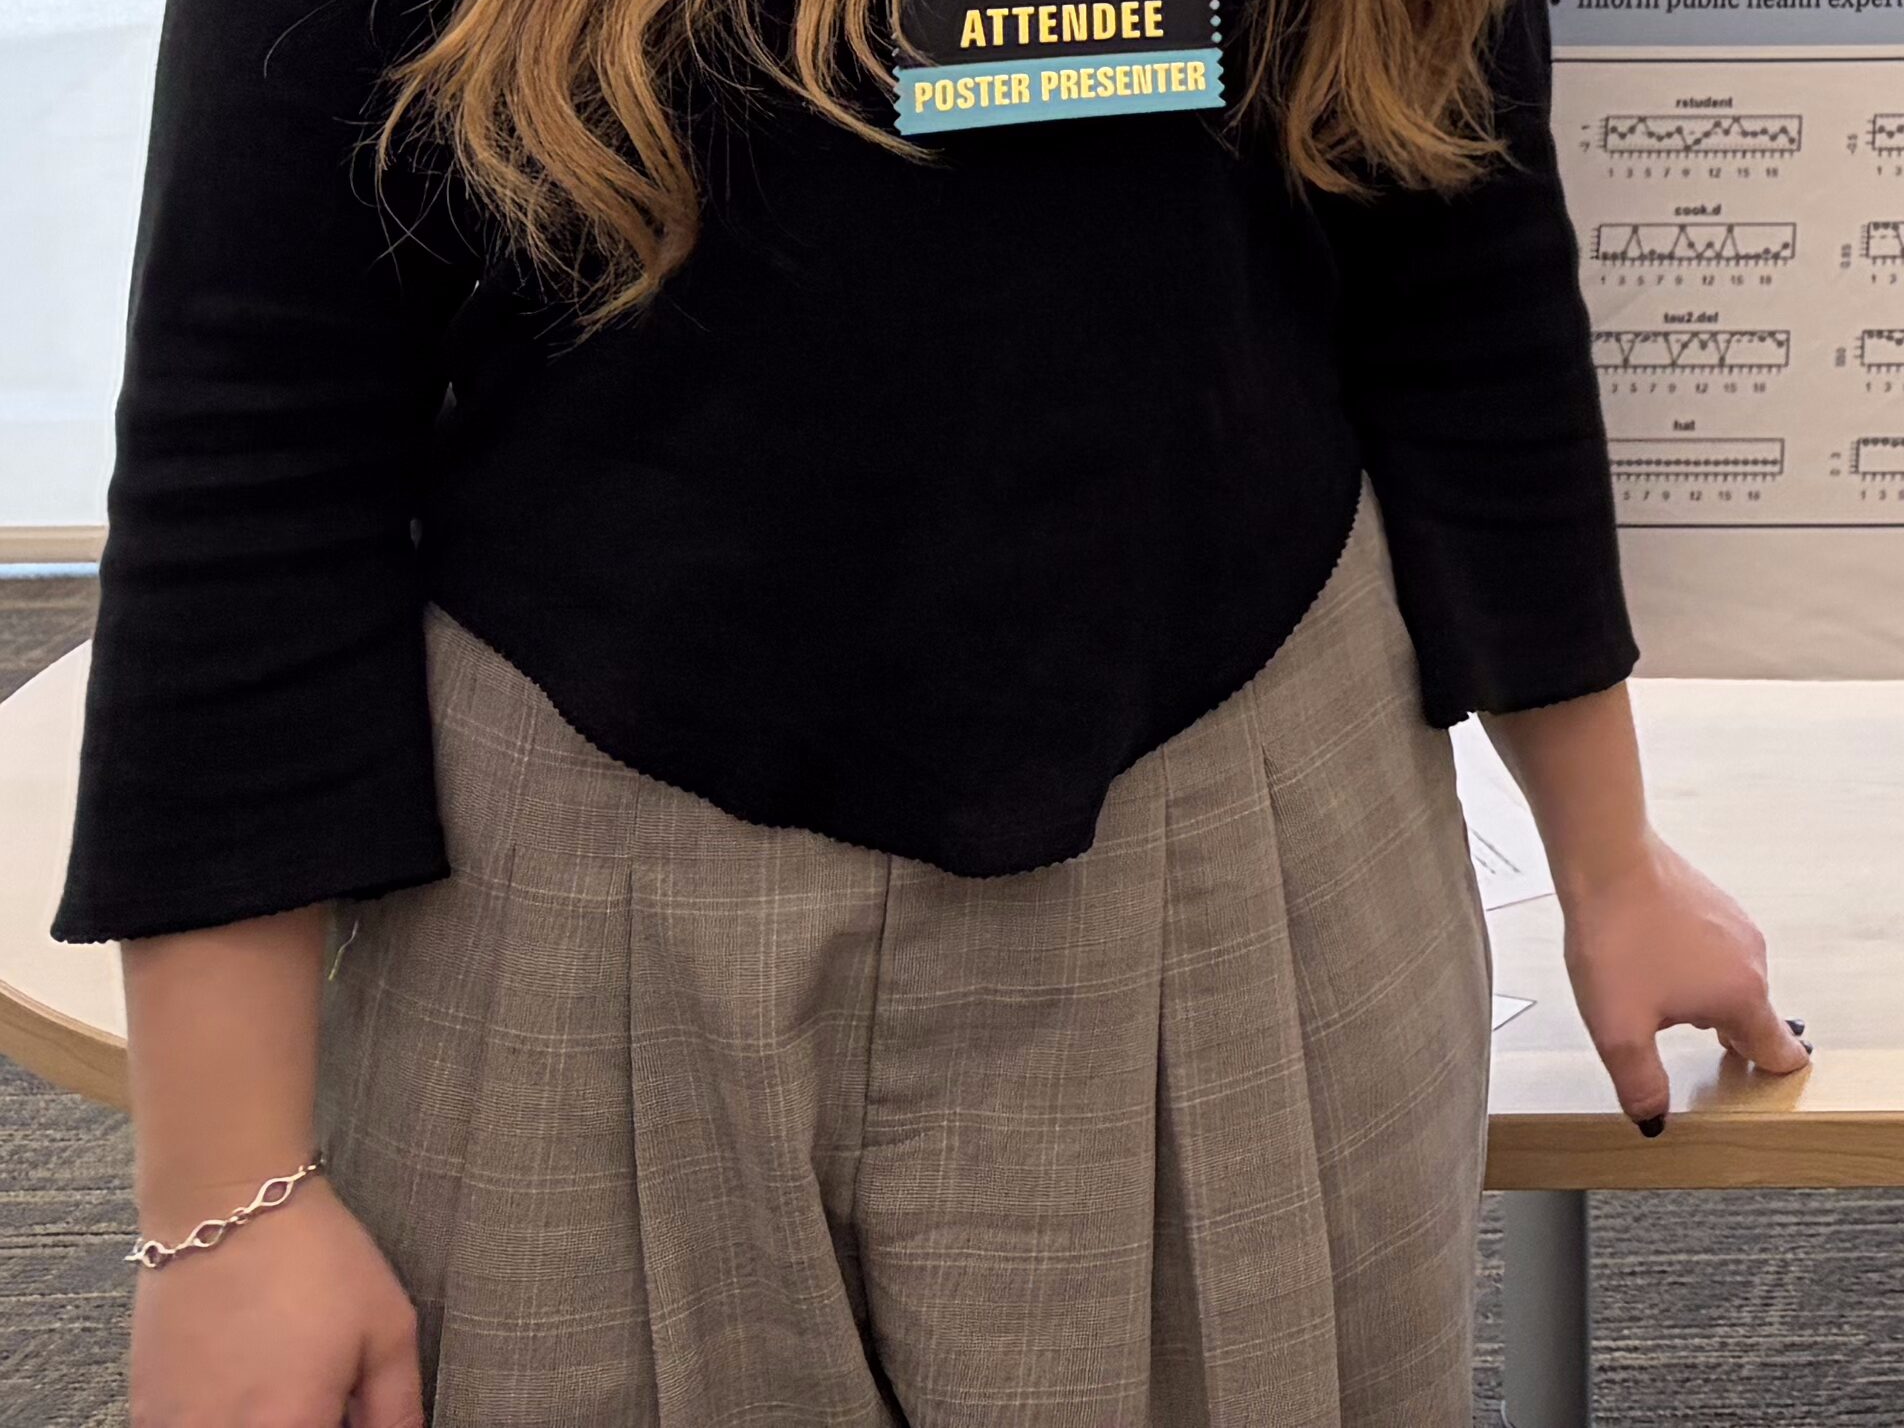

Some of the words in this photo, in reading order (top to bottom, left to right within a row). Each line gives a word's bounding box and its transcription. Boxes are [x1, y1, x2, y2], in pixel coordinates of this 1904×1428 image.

[959, 0, 1164, 49] ATTENDEE
[914, 72, 1030, 114] POSTER
[1040, 60, 1206, 102] PRESENTER
